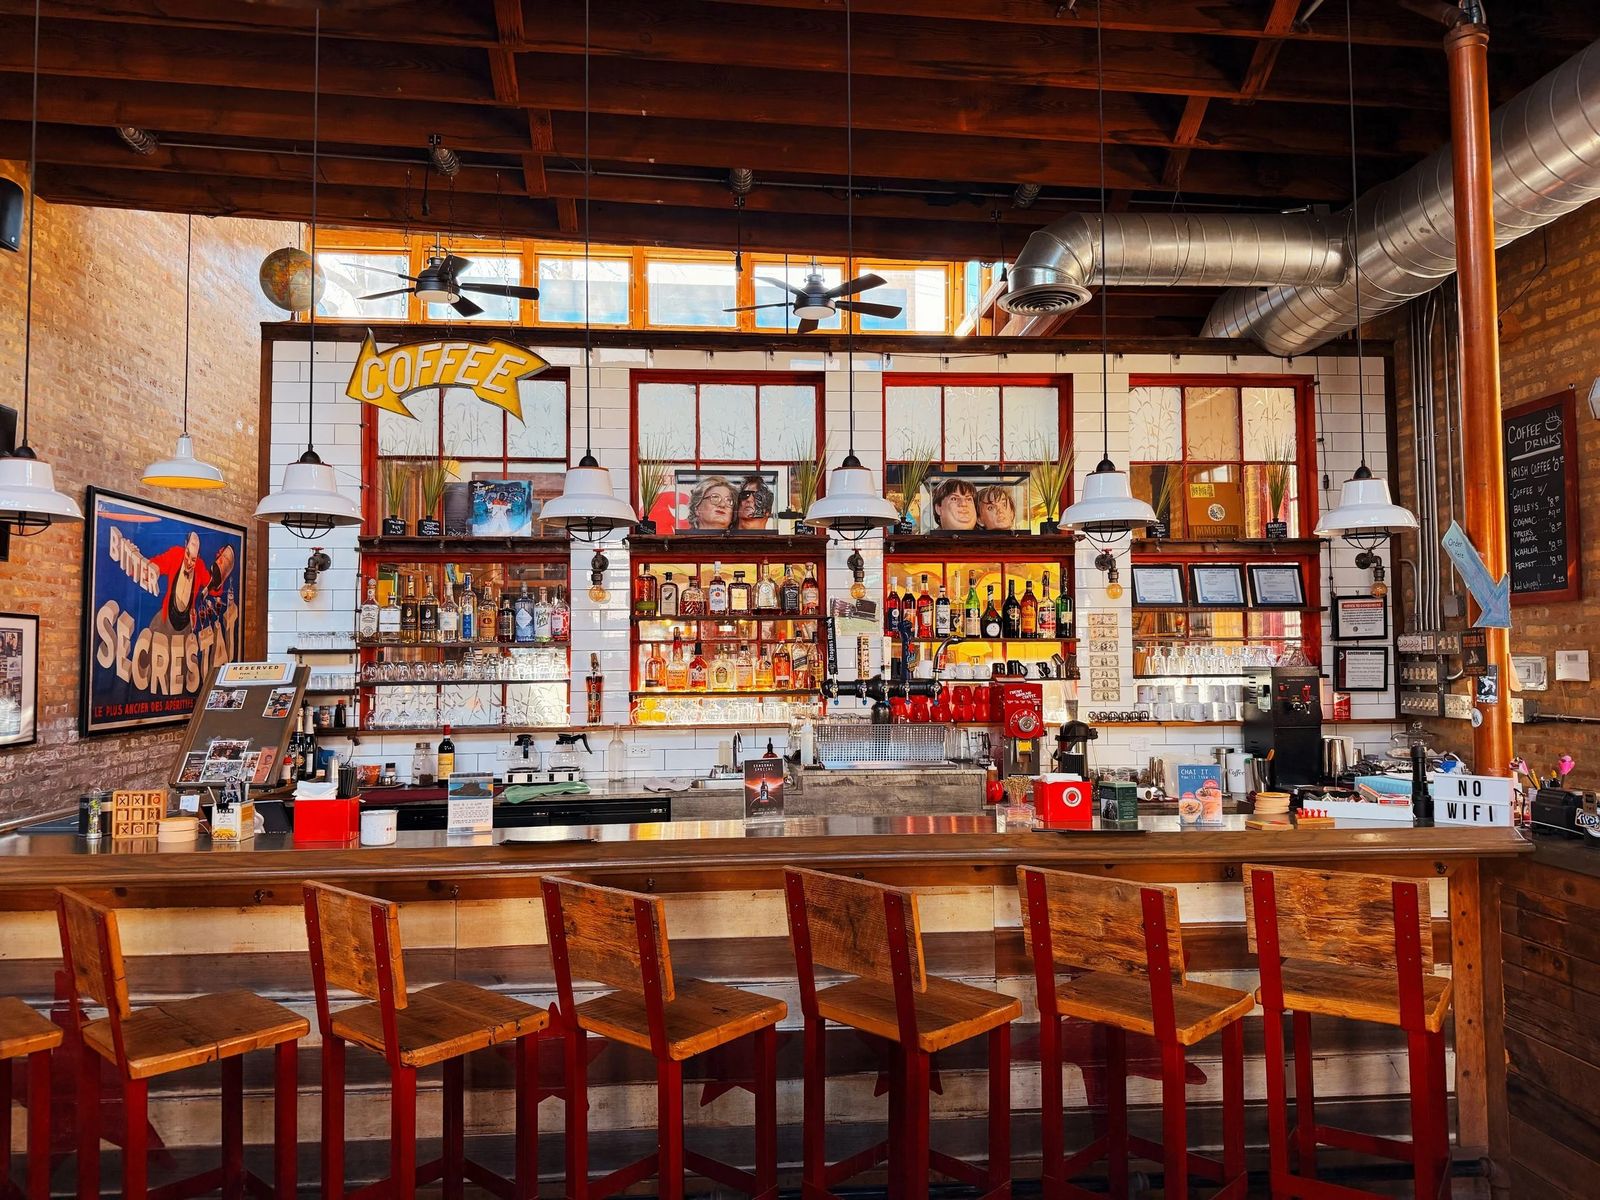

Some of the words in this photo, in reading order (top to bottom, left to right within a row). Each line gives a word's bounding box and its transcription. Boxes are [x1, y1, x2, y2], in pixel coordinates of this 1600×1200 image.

[361, 343, 527, 400] COFFEE
[1507, 422, 1541, 444] COFFEE
[1524, 432, 1562, 452] DRINKS
[1511, 465, 1528, 478] IRISH
[1530, 459, 1551, 475] COFFEE
[1193, 525, 1236, 536] IMMORTAL
[1512, 516, 1537, 528] COGNAC
[1447, 538, 1463, 548] Order
[109, 526, 160, 597] BITTER
[94, 704, 103, 717] LE
[106, 703, 123, 716] PLUS
[124, 702, 149, 715] ANCIEN
[151, 700, 163, 712] DES
[1228, 768, 1247, 777] Coffee
[1458, 780, 1482, 797] NO
[1447, 802, 1494, 822] WIFI
